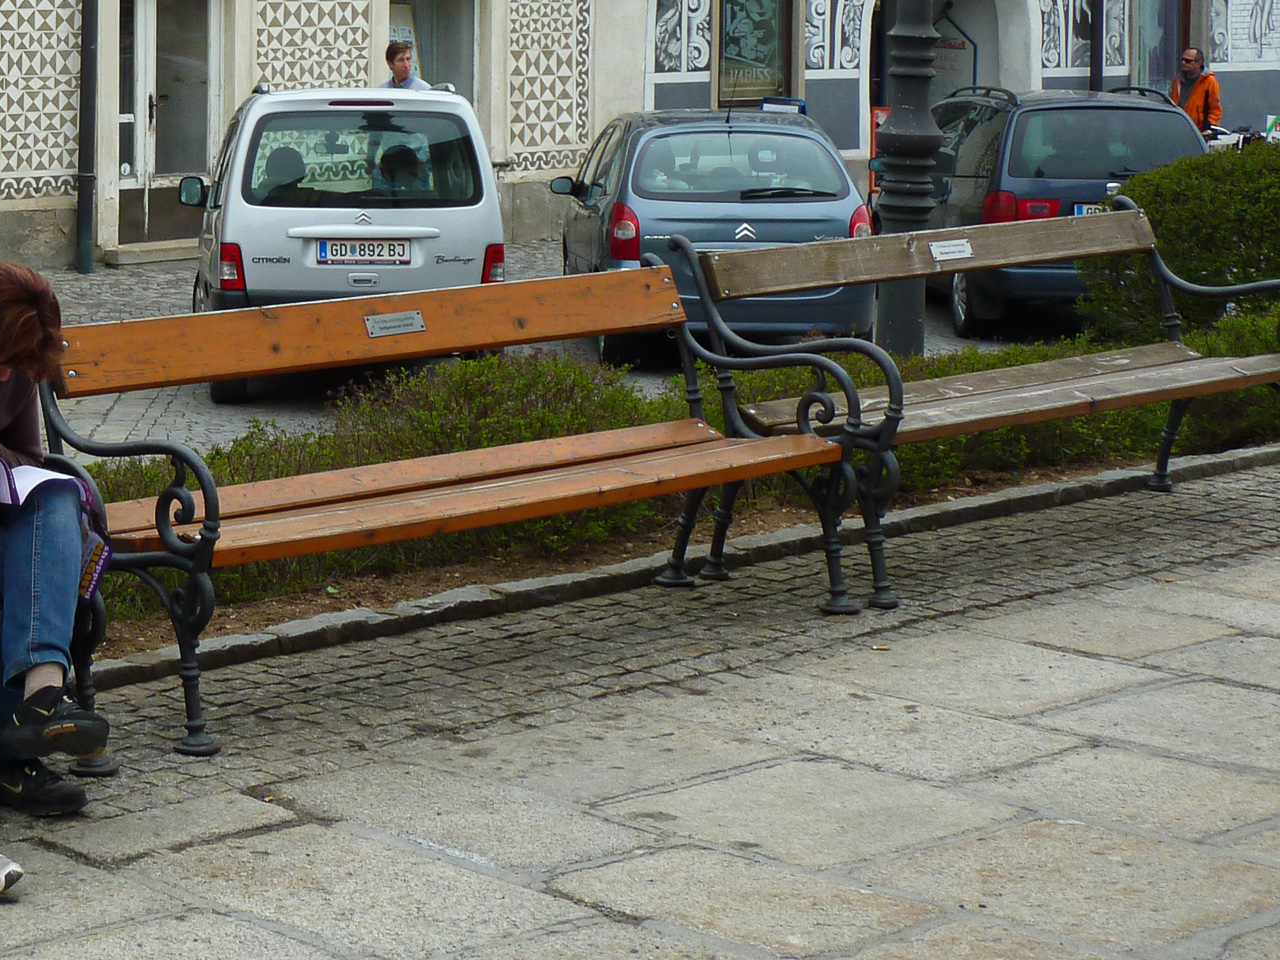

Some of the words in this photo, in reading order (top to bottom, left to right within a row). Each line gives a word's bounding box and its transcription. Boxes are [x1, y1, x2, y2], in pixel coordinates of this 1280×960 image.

[330, 243, 348, 257] GD
[358, 242, 384, 257] 892
[388, 243, 405, 257] BJ
[252, 255, 290, 264] CITROËN
[434, 254, 476, 265] Berlingo
